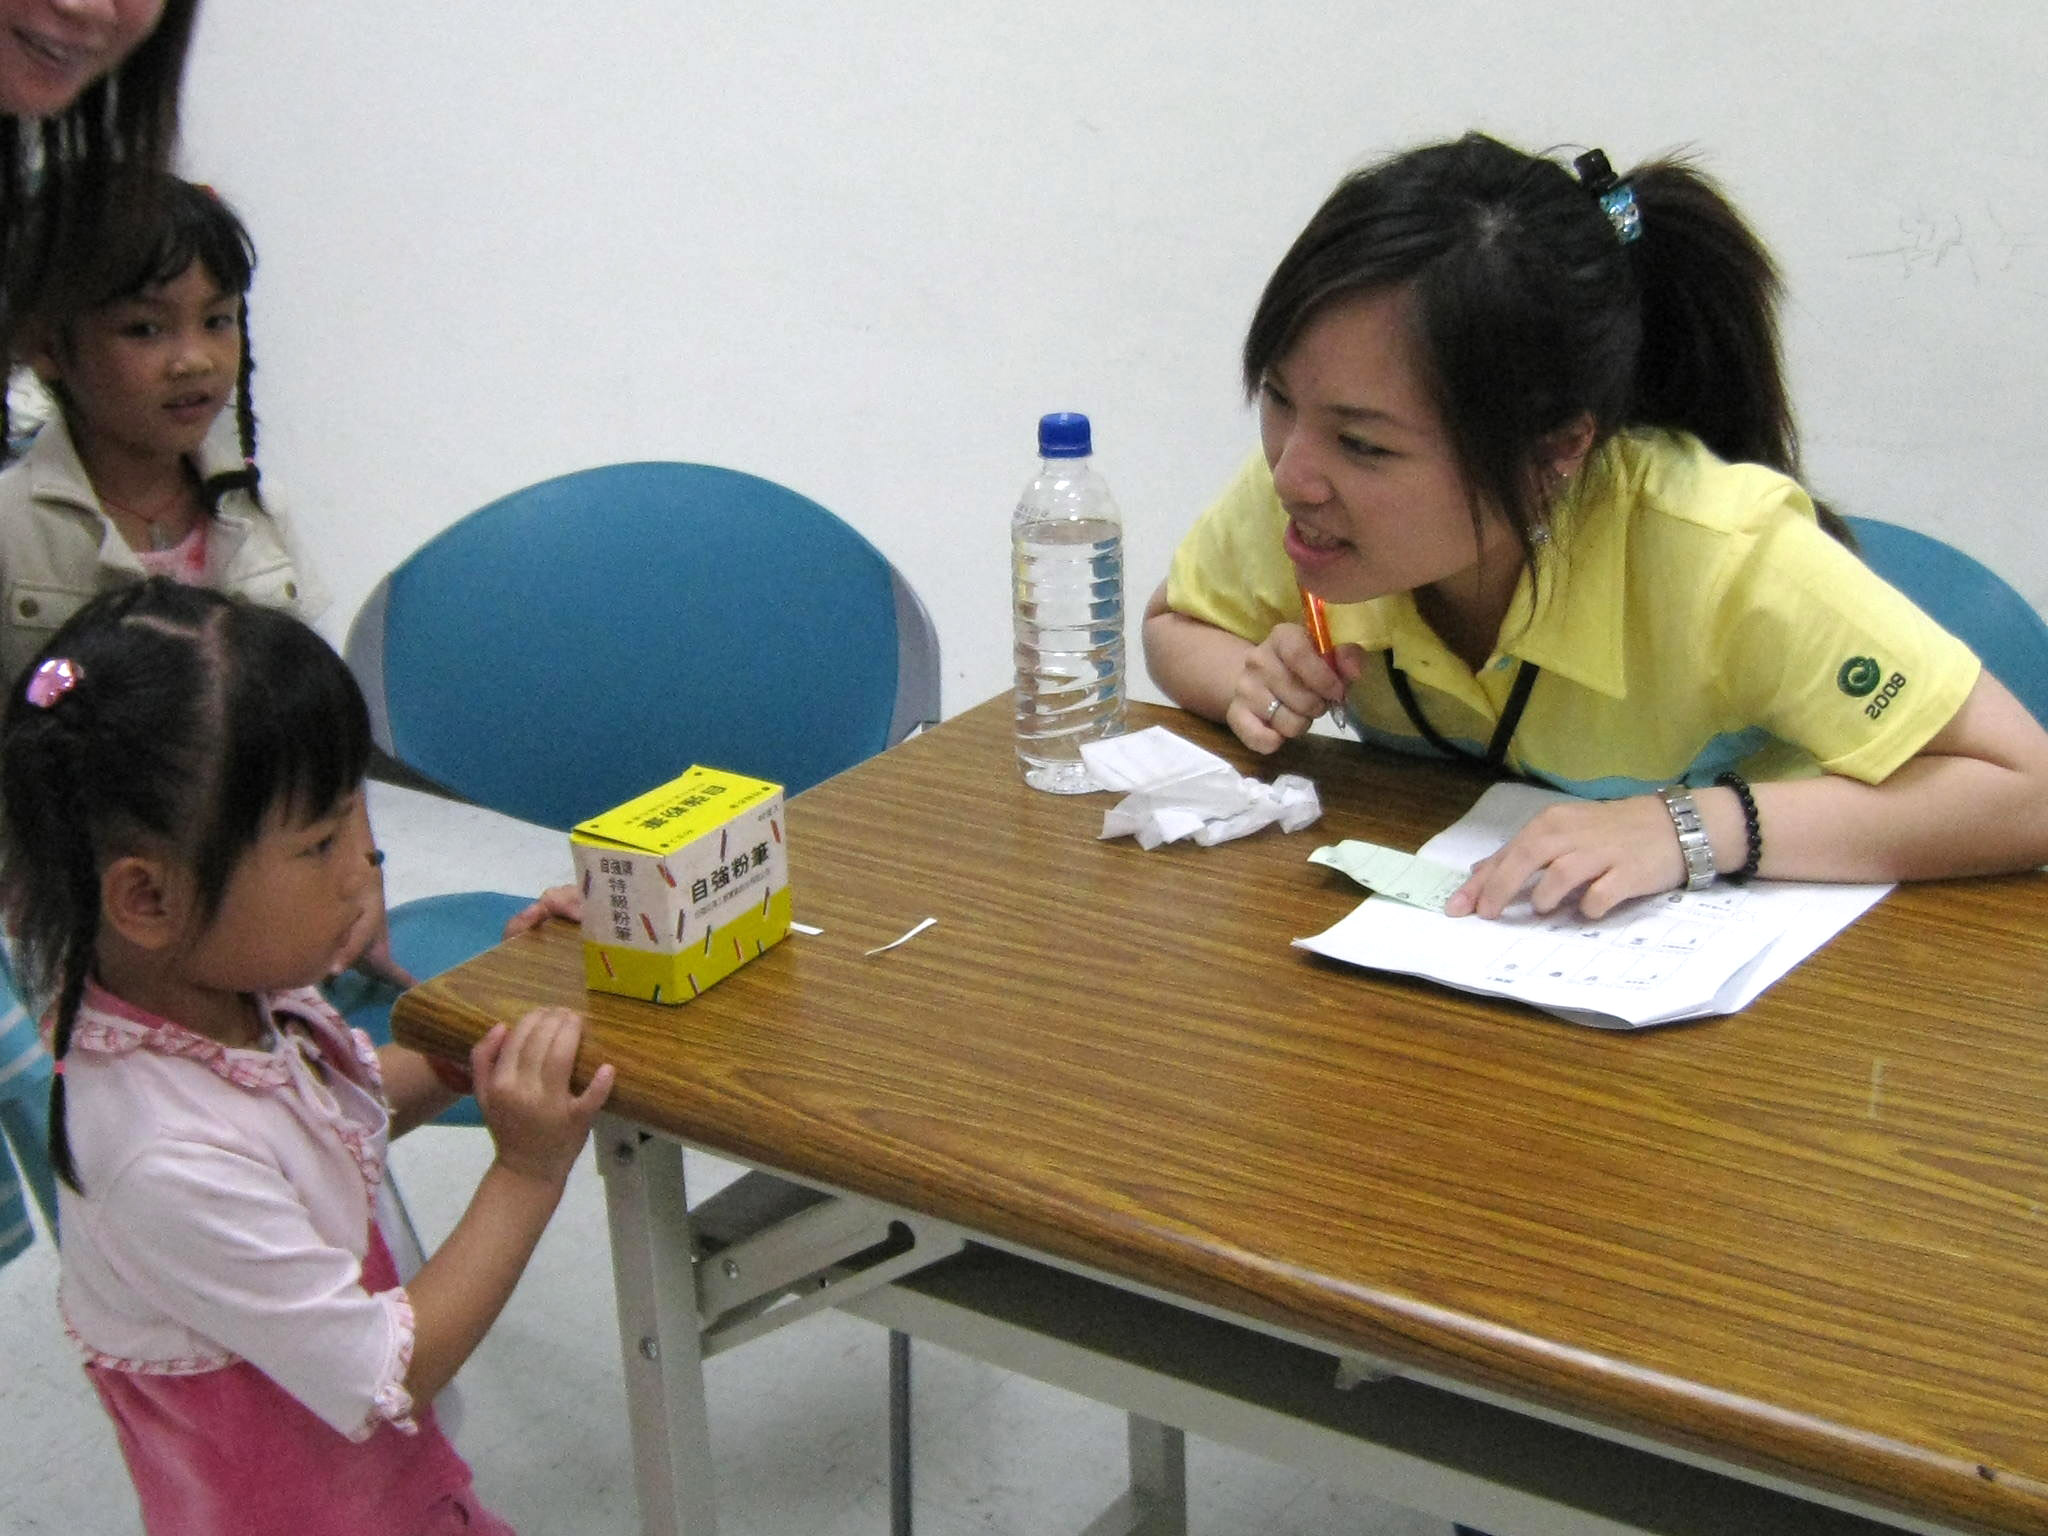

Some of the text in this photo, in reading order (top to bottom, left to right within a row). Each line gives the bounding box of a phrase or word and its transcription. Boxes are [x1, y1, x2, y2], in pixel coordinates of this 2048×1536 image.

[1864, 671, 1906, 720] 2008
[691, 841, 769, 904] 自強粉筆
